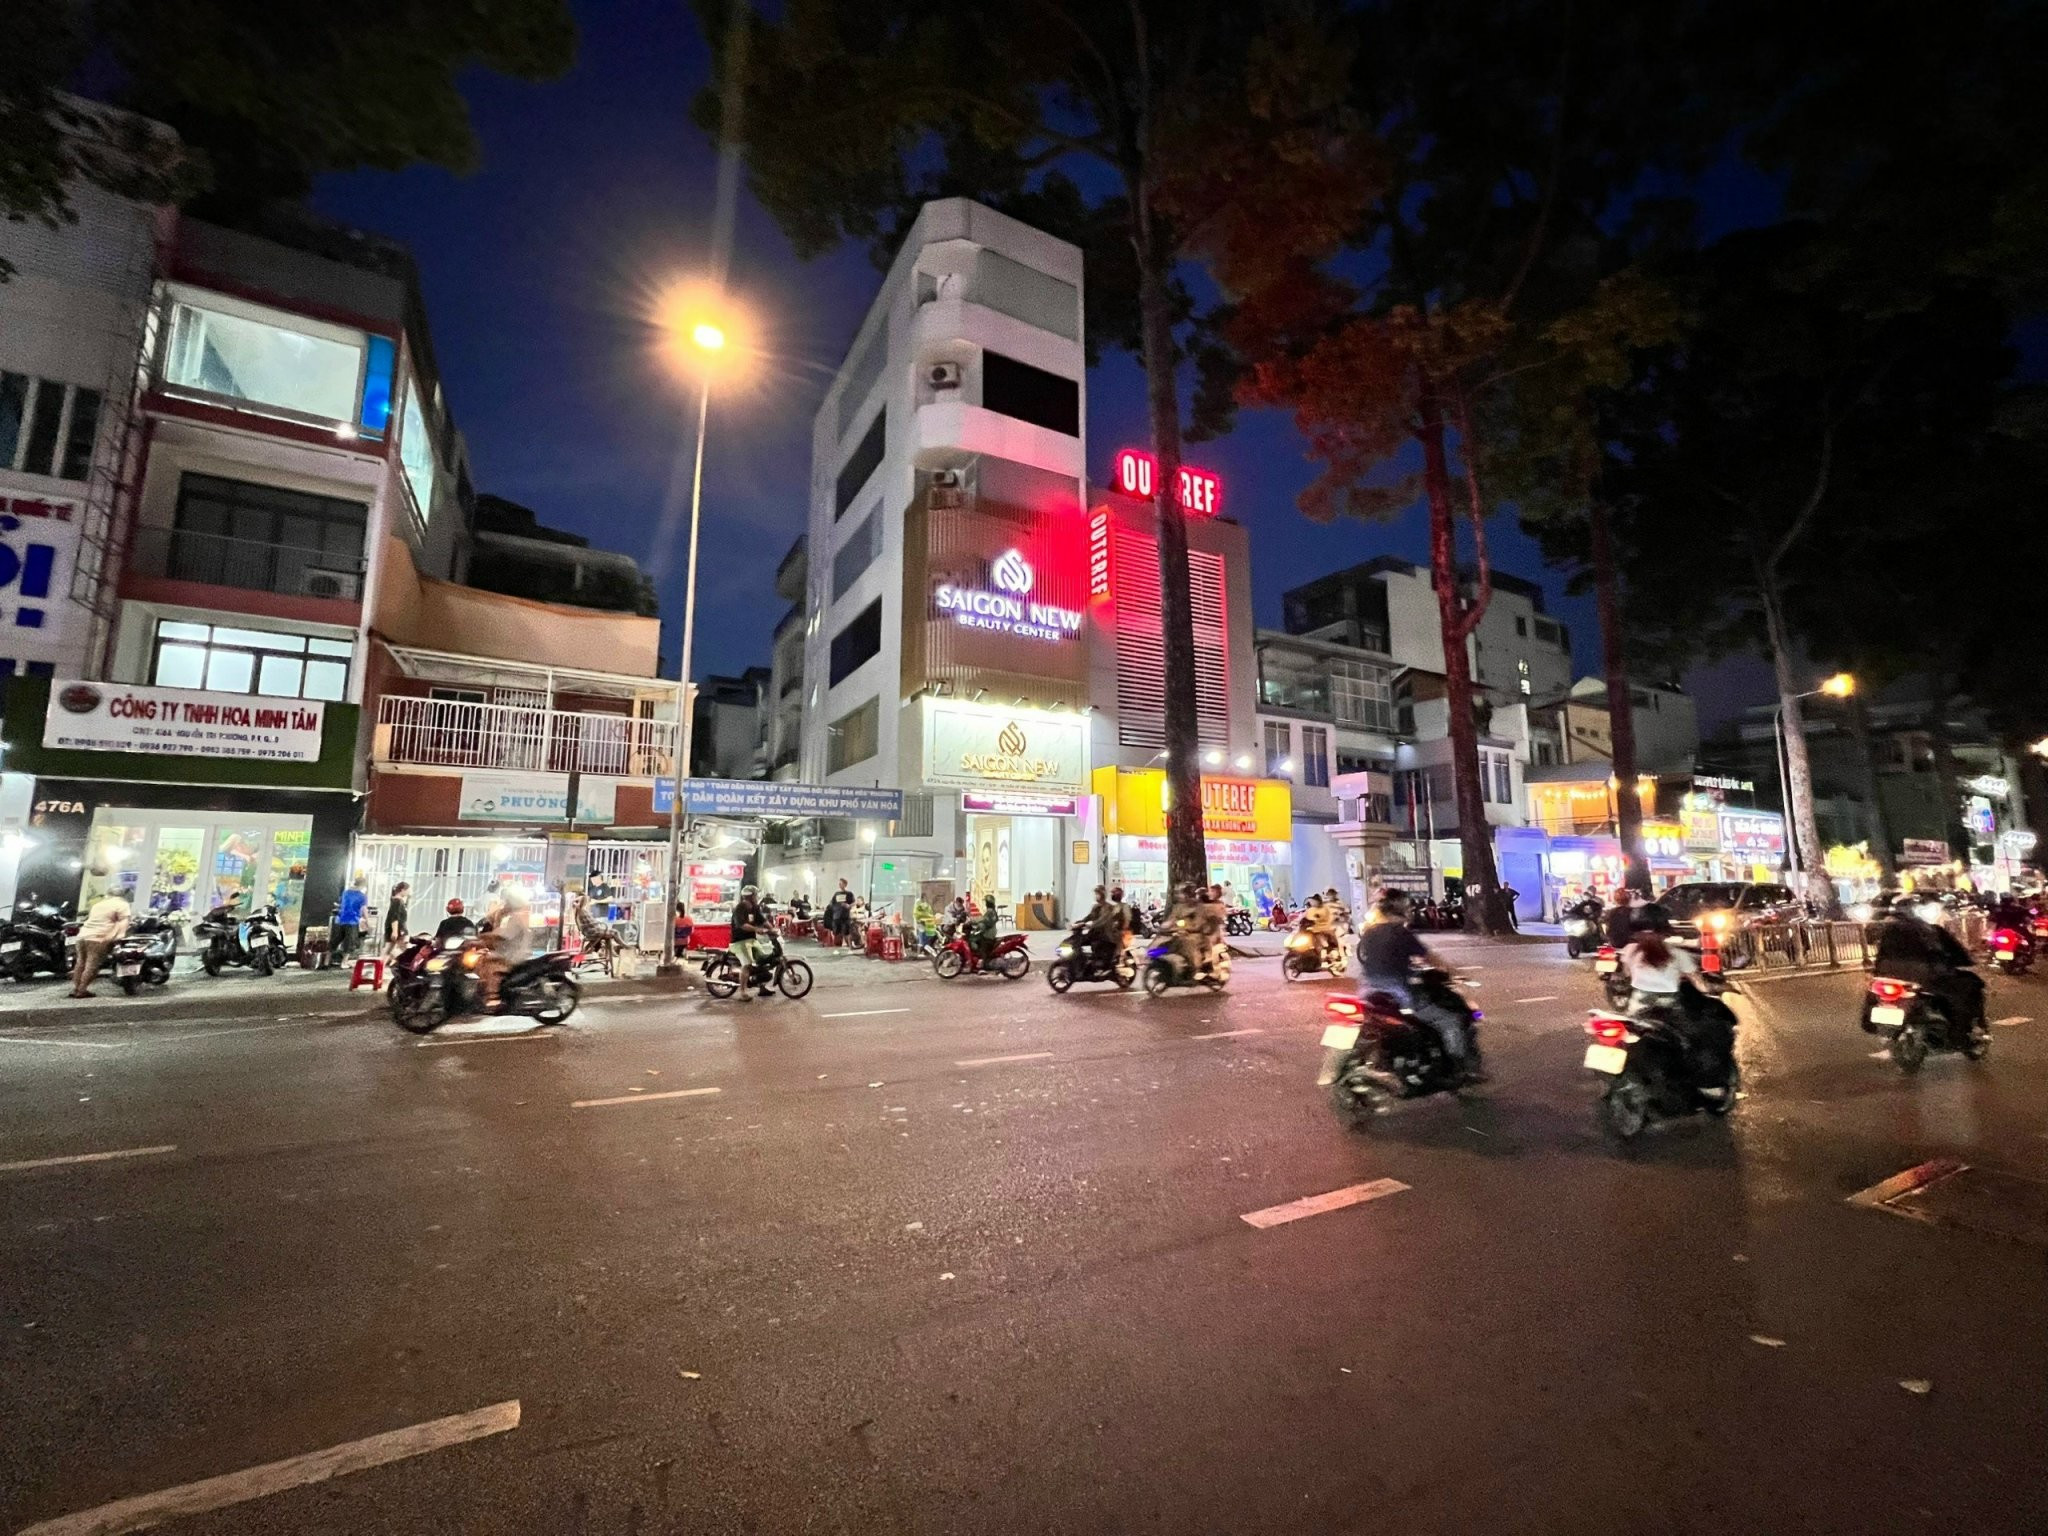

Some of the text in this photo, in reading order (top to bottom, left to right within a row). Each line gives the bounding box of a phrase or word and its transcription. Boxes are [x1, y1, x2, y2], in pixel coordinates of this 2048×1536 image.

[1123, 455, 1215, 513] OUREF
[1090, 512, 1108, 595] OUTEREF
[936, 585, 1081, 630] SAIGON NEW
[959, 614, 1060, 640] BEAUTY CENTER
[110, 693, 157, 719] CÔNG
[162, 701, 179, 721] TY
[184, 703, 218, 725] TNHH
[255, 708, 288, 729] MINH
[291, 707, 318, 731] TÂM
[1022, 759, 1059, 776] NEW
[34, 800, 85, 813] 476A
[692, 792, 713, 802] DÂN
[716, 792, 744, 803] ĐOÀN
[747, 793, 766, 804] KẾT
[768, 794, 788, 805] XÂY
[790, 797, 816, 808] DỰNG
[818, 798, 838, 808] KHU
[840, 797, 858, 808] PHỐ
[861, 799, 878, 809] VĂN
[880, 801, 898, 810] HÓA
[1203, 782, 1256, 811] UTEREF
[274, 831, 304, 842] MINH
